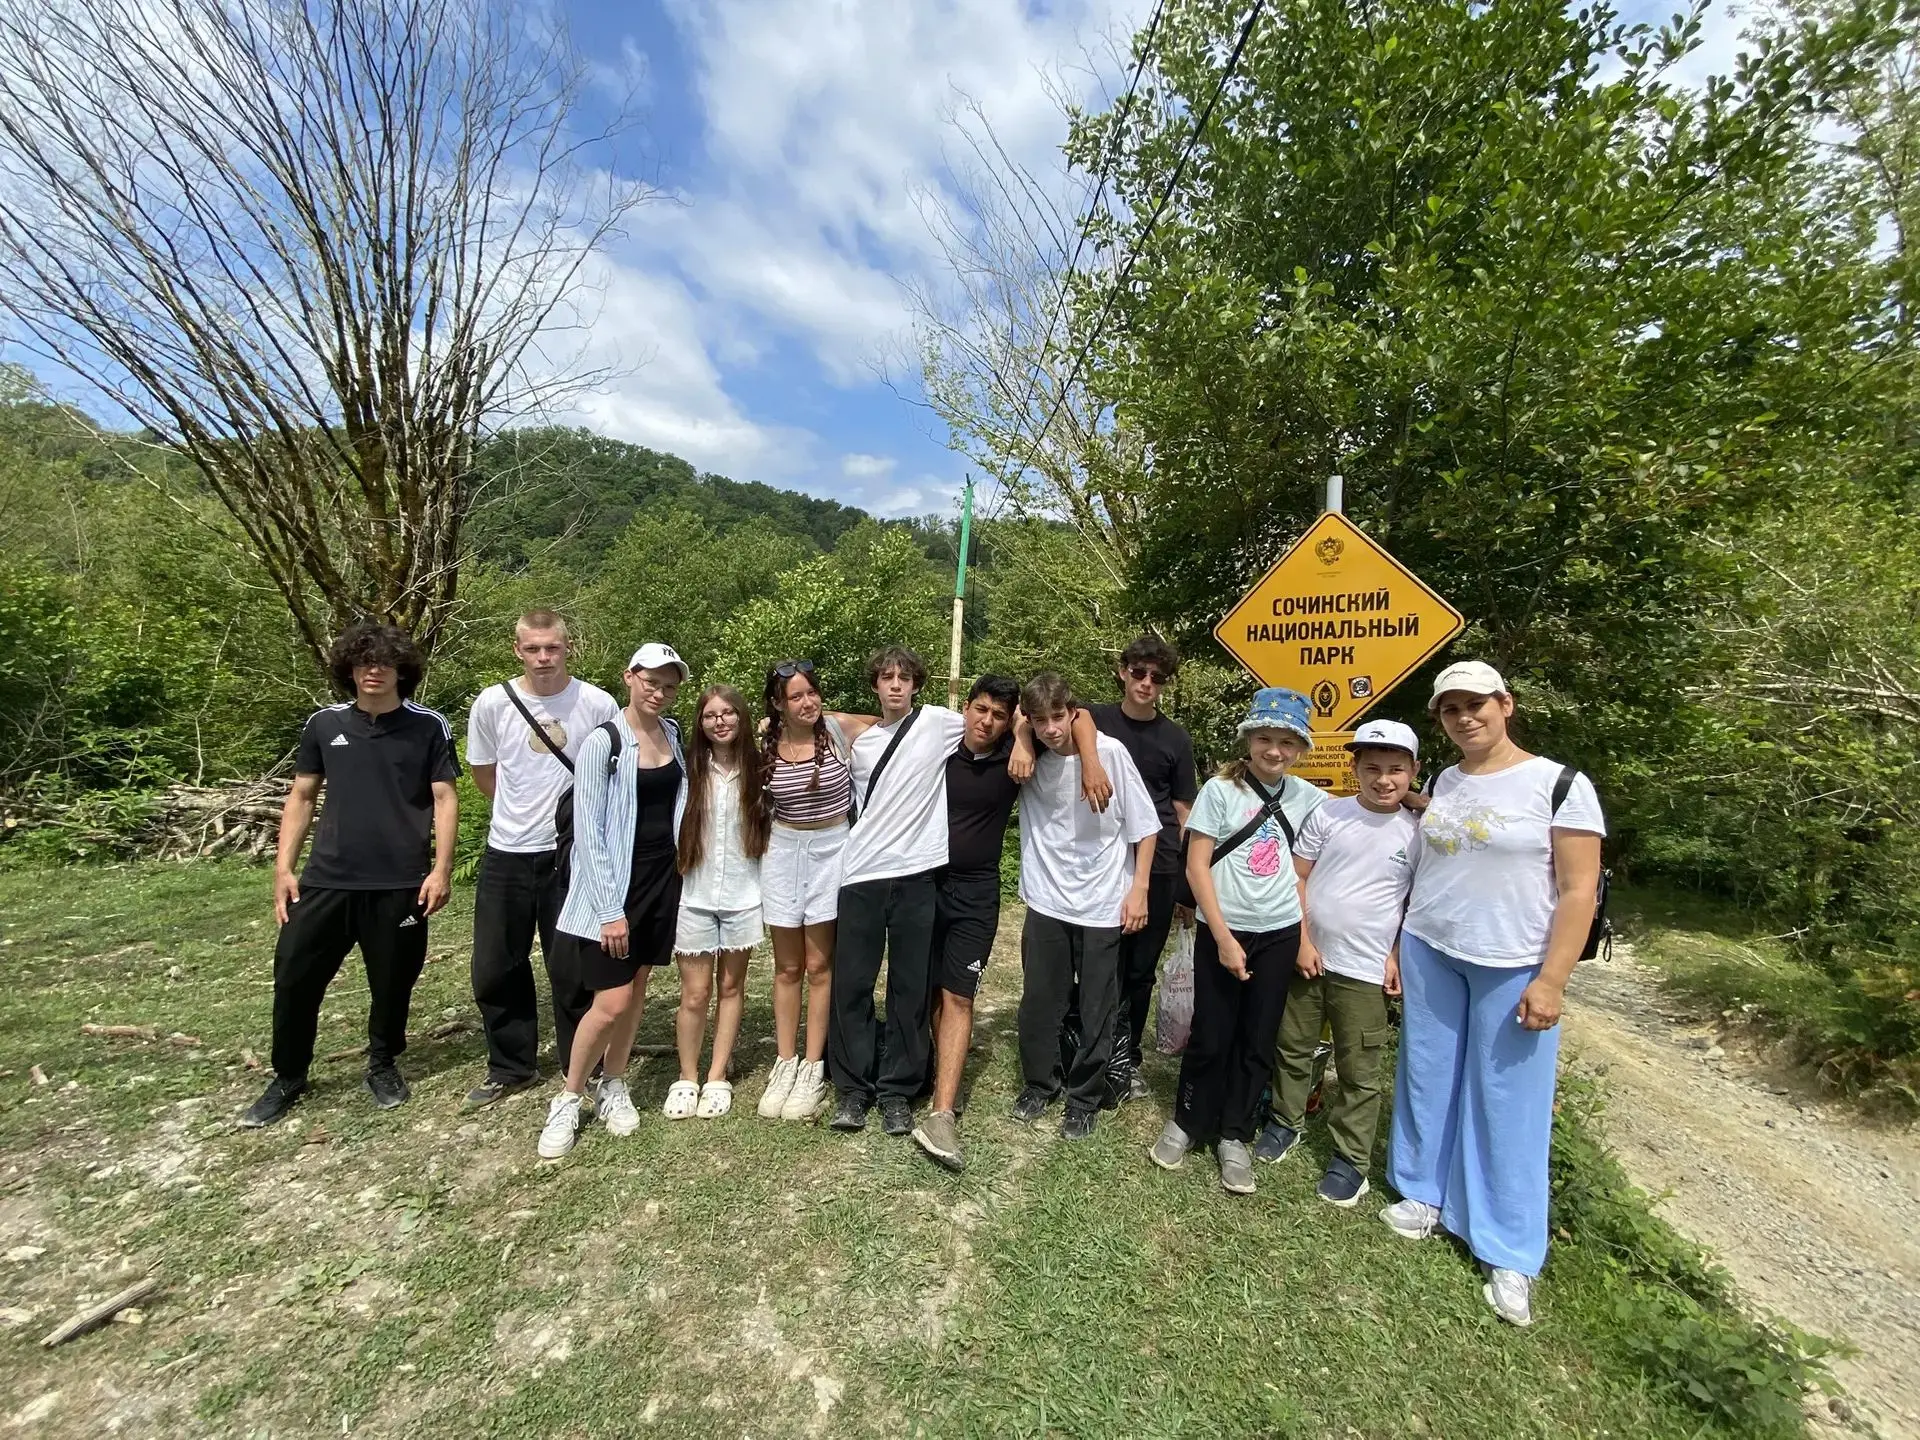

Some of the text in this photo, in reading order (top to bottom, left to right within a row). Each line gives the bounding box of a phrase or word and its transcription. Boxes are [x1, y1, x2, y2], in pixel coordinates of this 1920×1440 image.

[1272, 588, 1389, 617] СОЧИНСКИЙ
[1247, 613, 1419, 643] НАЦИОНАЛЬНЫЙ
[1300, 646, 1355, 665] ПАРК
